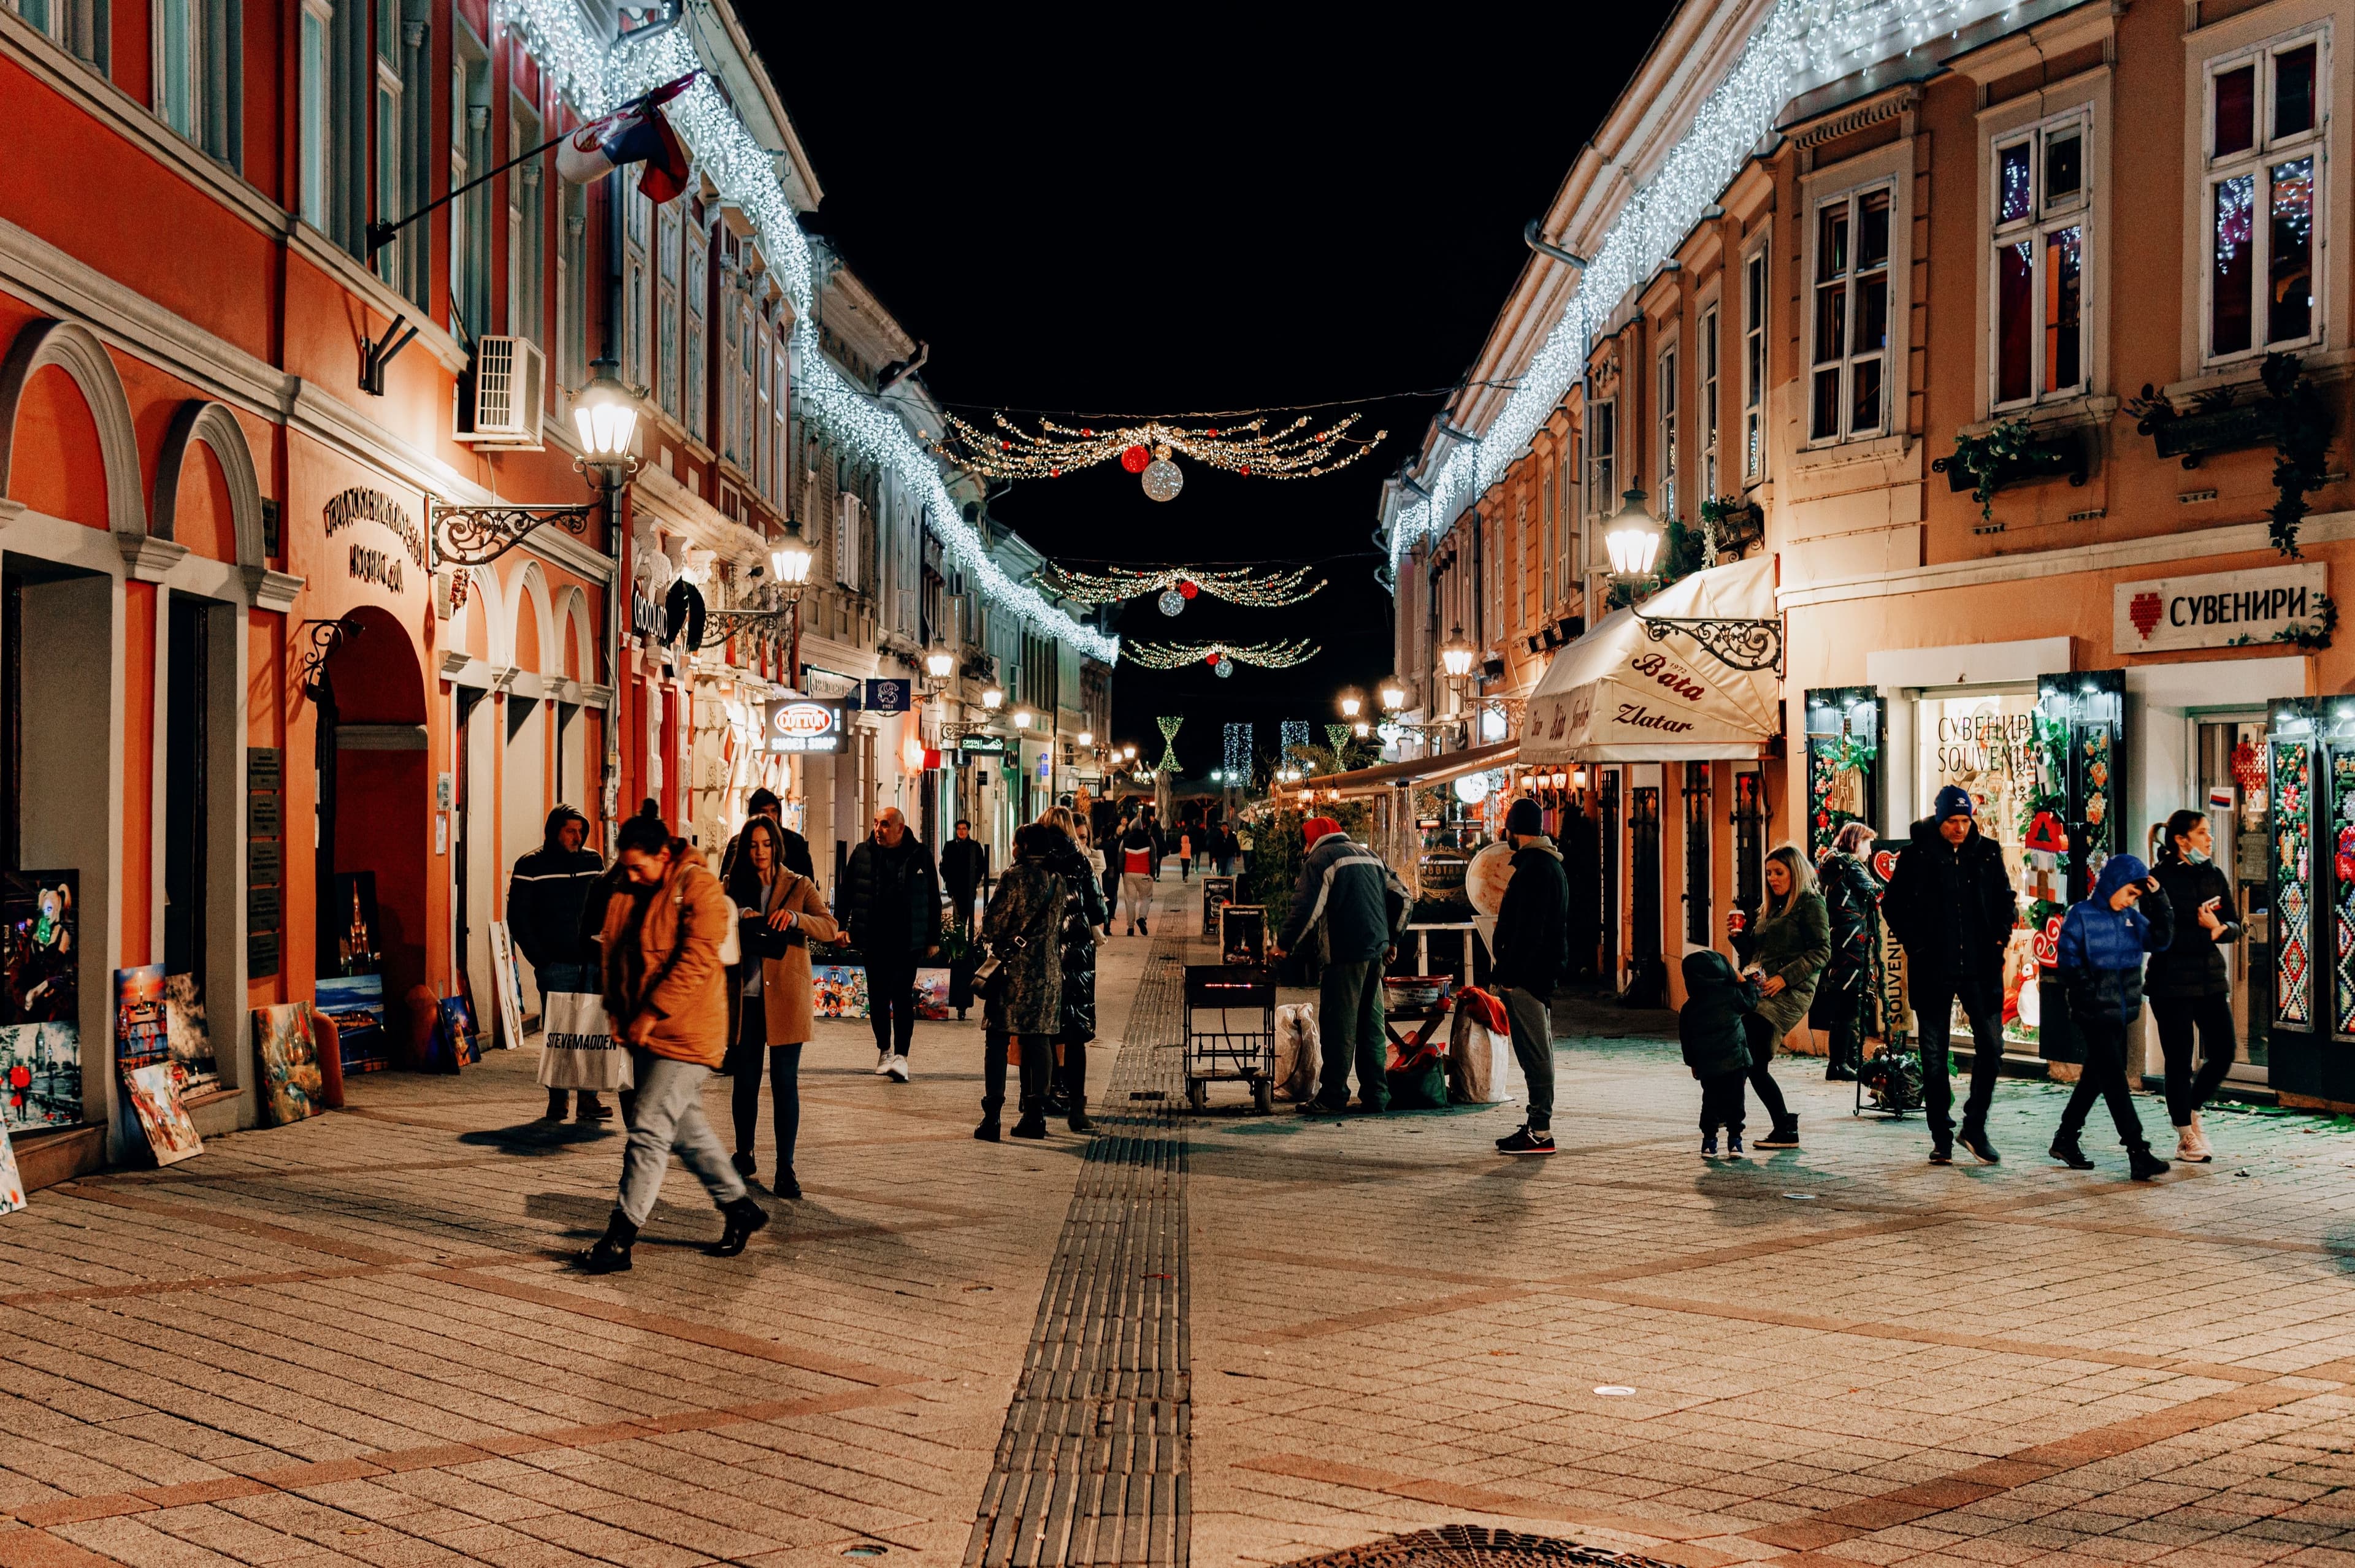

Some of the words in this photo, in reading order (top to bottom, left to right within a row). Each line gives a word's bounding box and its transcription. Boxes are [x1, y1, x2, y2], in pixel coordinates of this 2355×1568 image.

[634, 590, 668, 640] CHOCOLATO
[2170, 586, 2306, 627] СУВЕНИРИ
[1631, 653, 1705, 702] Bata
[1669, 662, 1687, 674] 1972
[779, 713, 825, 728] COTTON
[1612, 703, 1694, 733] Zlatar
[772, 737, 806, 751] SHOES
[808, 736, 837, 750] SHOP
